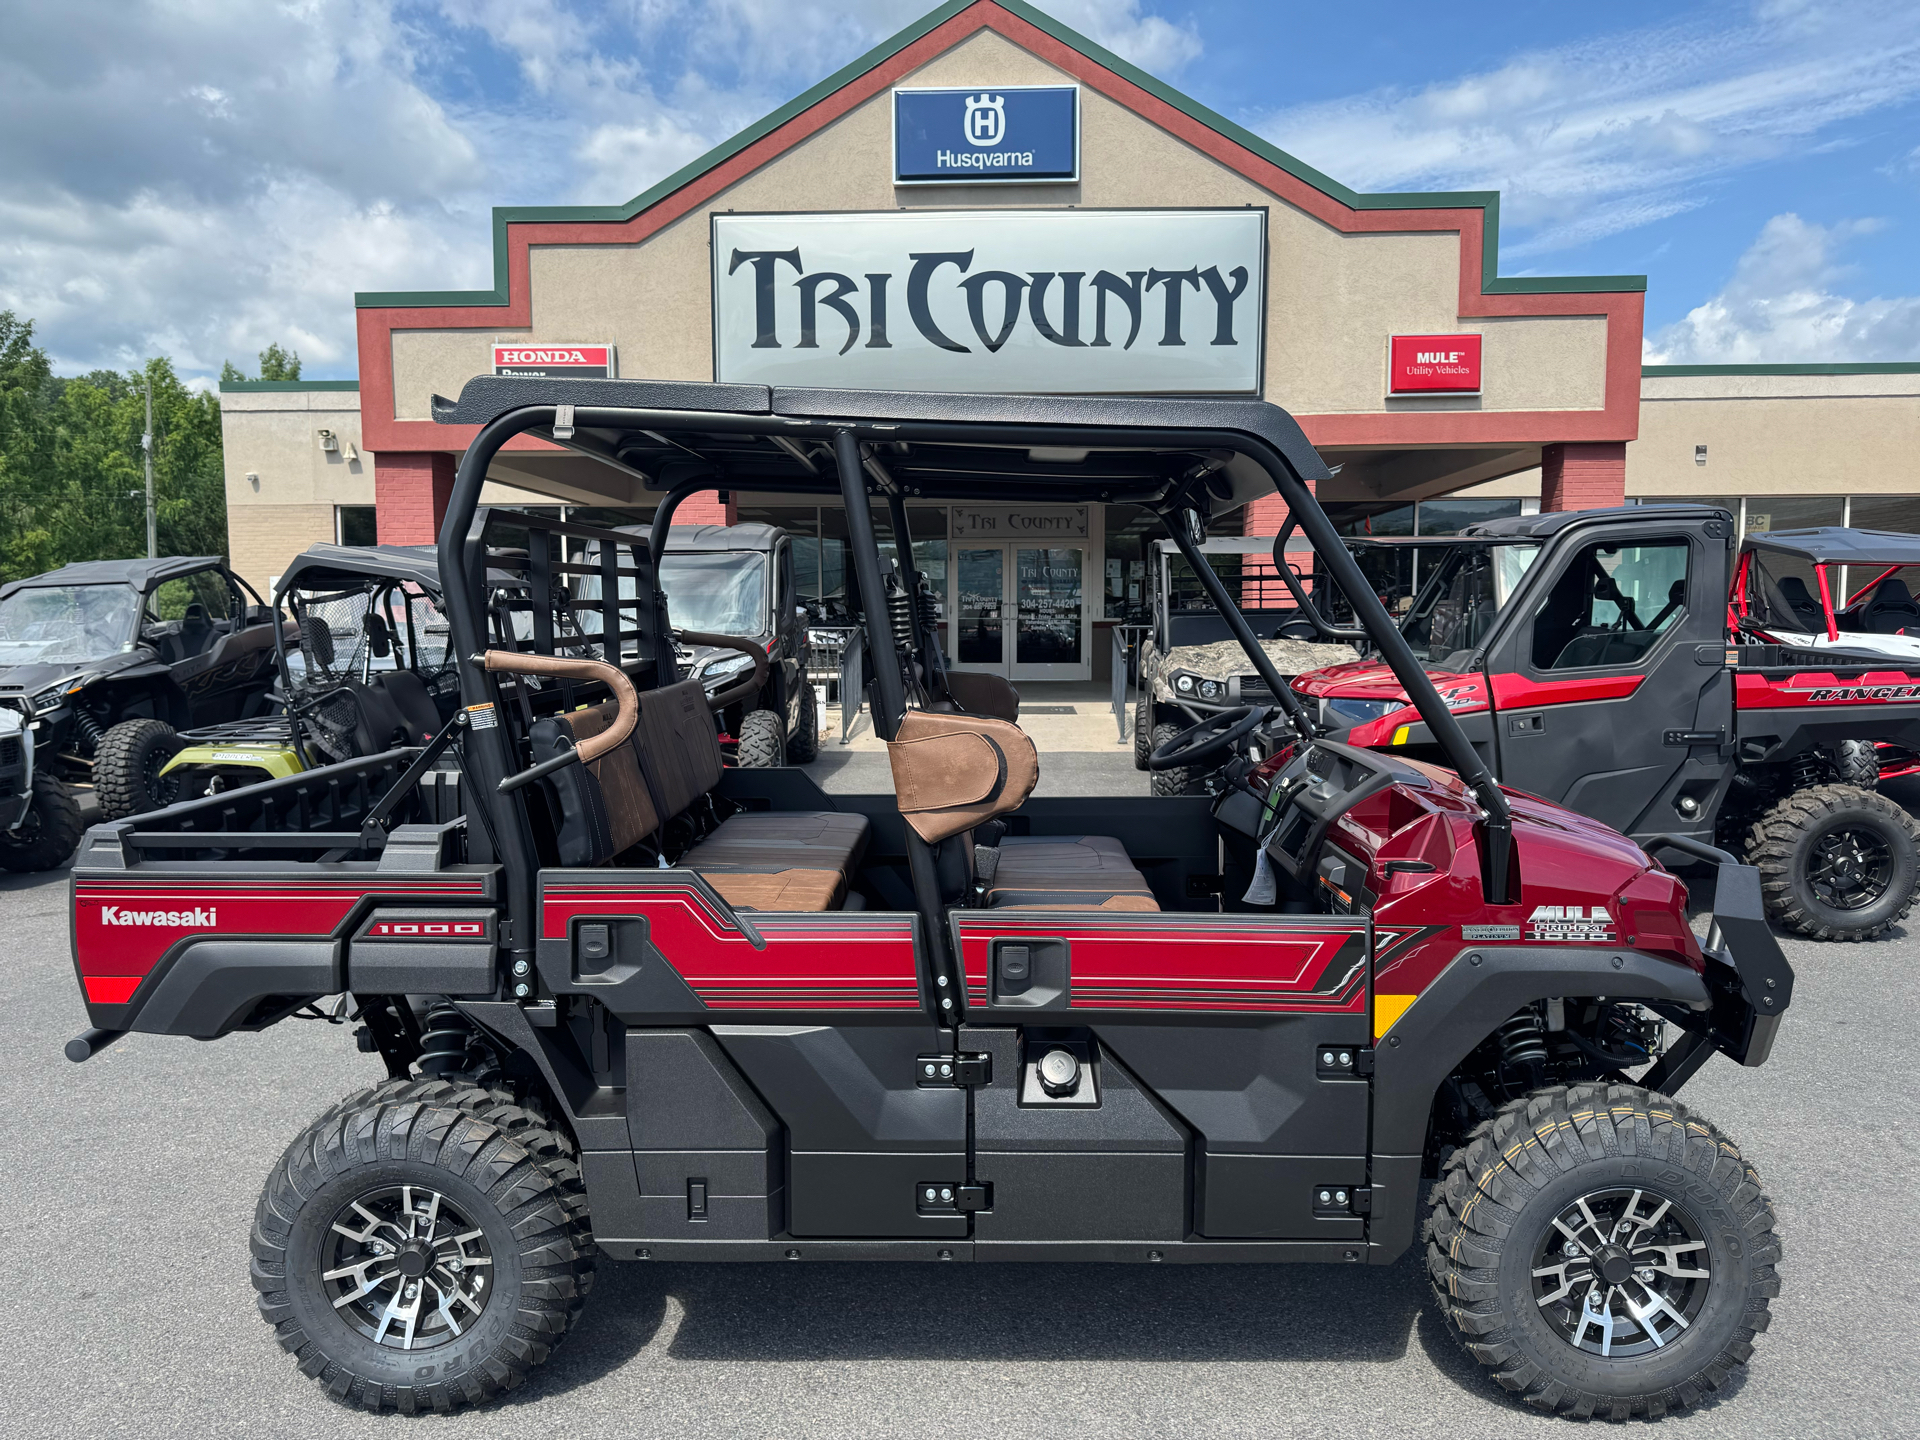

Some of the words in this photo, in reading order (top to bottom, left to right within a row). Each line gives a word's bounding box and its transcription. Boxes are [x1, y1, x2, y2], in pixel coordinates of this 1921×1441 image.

[937, 150, 1034, 170] Husqvarna
[906, 247, 1250, 354] COUNTY
[501, 350, 587, 363] HONDA
[1406, 366, 1434, 377] Utility
[1436, 365, 1470, 375] Vehicles
[1008, 513, 1073, 530] COUNTY
[1042, 566, 1078, 578] COUNTY
[1020, 598, 1075, 609] 304-257-4420
[101, 906, 217, 927] Kawasaki
[1526, 905, 1615, 925] MULE
[379, 924, 480, 934] 1000
[1534, 931, 1610, 941] 1000
[1653, 1168, 1747, 1260] DURO
[414, 1316, 506, 1381] DURO
